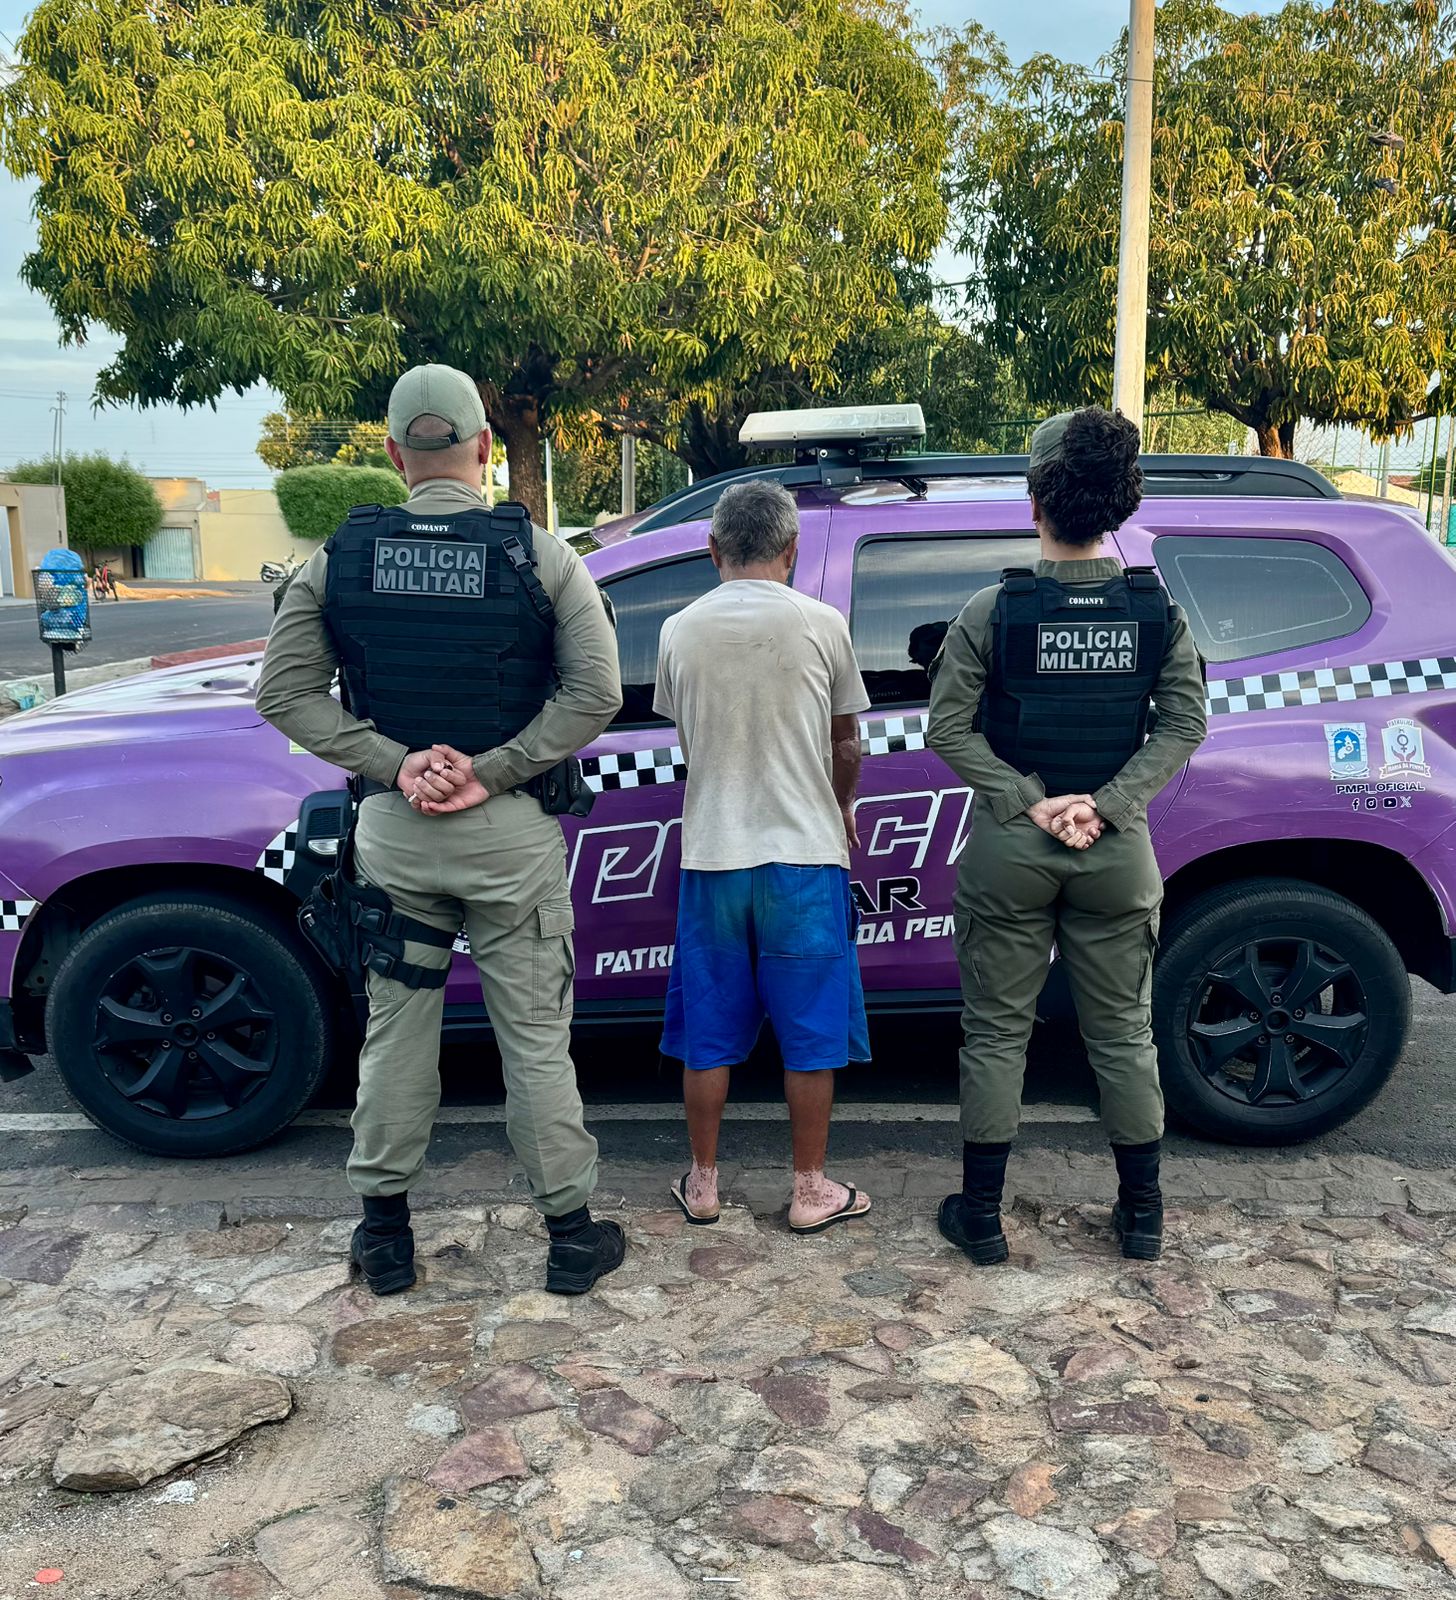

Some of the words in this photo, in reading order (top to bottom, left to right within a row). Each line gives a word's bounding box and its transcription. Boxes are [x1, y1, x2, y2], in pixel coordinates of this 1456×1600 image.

[377, 544, 482, 571] POLÍCIA
[376, 568, 481, 595] MILITAR
[1040, 626, 1133, 650] POLÍCIA
[1039, 650, 1133, 670] MILITAR
[1336, 781, 1426, 795] PMPI_OFICIAL
